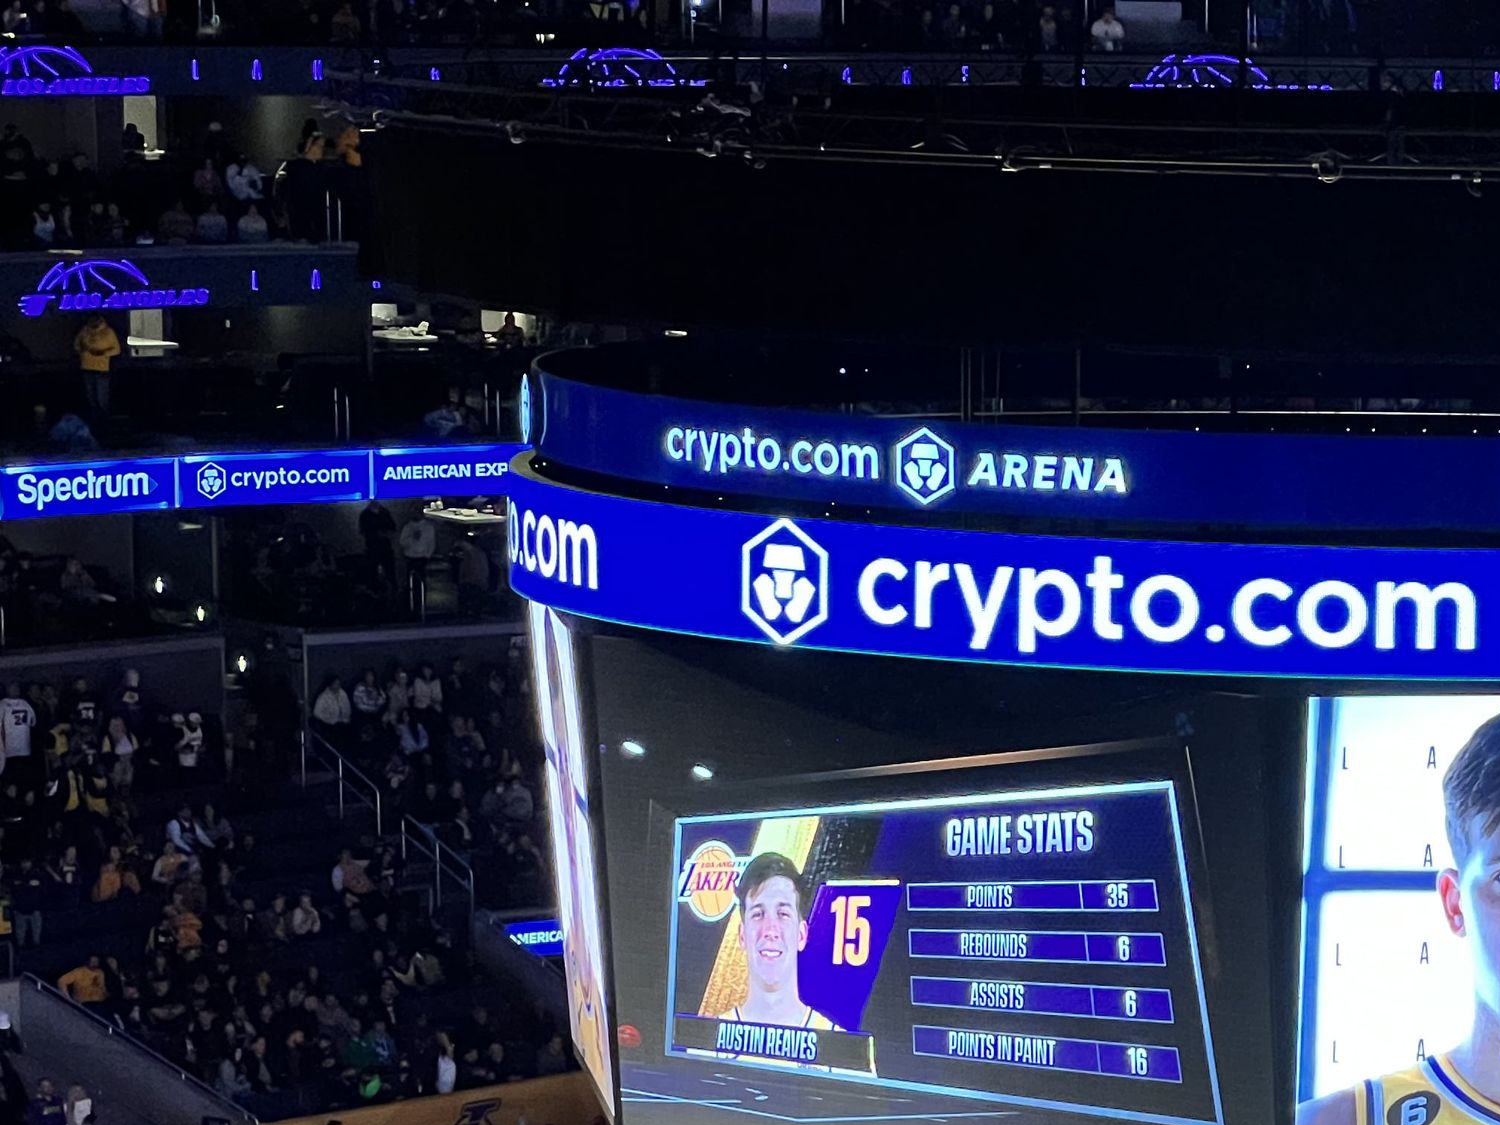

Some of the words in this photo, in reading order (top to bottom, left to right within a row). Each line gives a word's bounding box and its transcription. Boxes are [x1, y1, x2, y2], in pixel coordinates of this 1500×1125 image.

[382, 463, 471, 482] AMERICAN
[666, 426, 880, 480] crypto.com
[967, 452, 1128, 494] ARENA
[17, 468, 151, 511] Spectrum
[230, 465, 350, 491] crypto.com
[857, 555, 1477, 654] crypto.com
[945, 815, 1012, 857] GAME
[1016, 810, 1095, 854] STATS
[678, 861, 741, 898] LAKER
[966, 884, 1013, 909] POINTS
[1107, 883, 1129, 908] 35
[830, 895, 872, 967] 15
[960, 932, 1027, 958] REBOUNDS
[1118, 935, 1131, 961] 6
[969, 982, 1025, 1009] ASSISTS
[1125, 990, 1137, 1018] 6
[716, 1022, 766, 1054] AUSTIN
[766, 1027, 818, 1061] REAVES
[948, 1030, 995, 1060] POINTS
[997, 1035, 1012, 1062] IN
[1014, 1036, 1057, 1067] PAINT
[1127, 1046, 1148, 1076] 16
